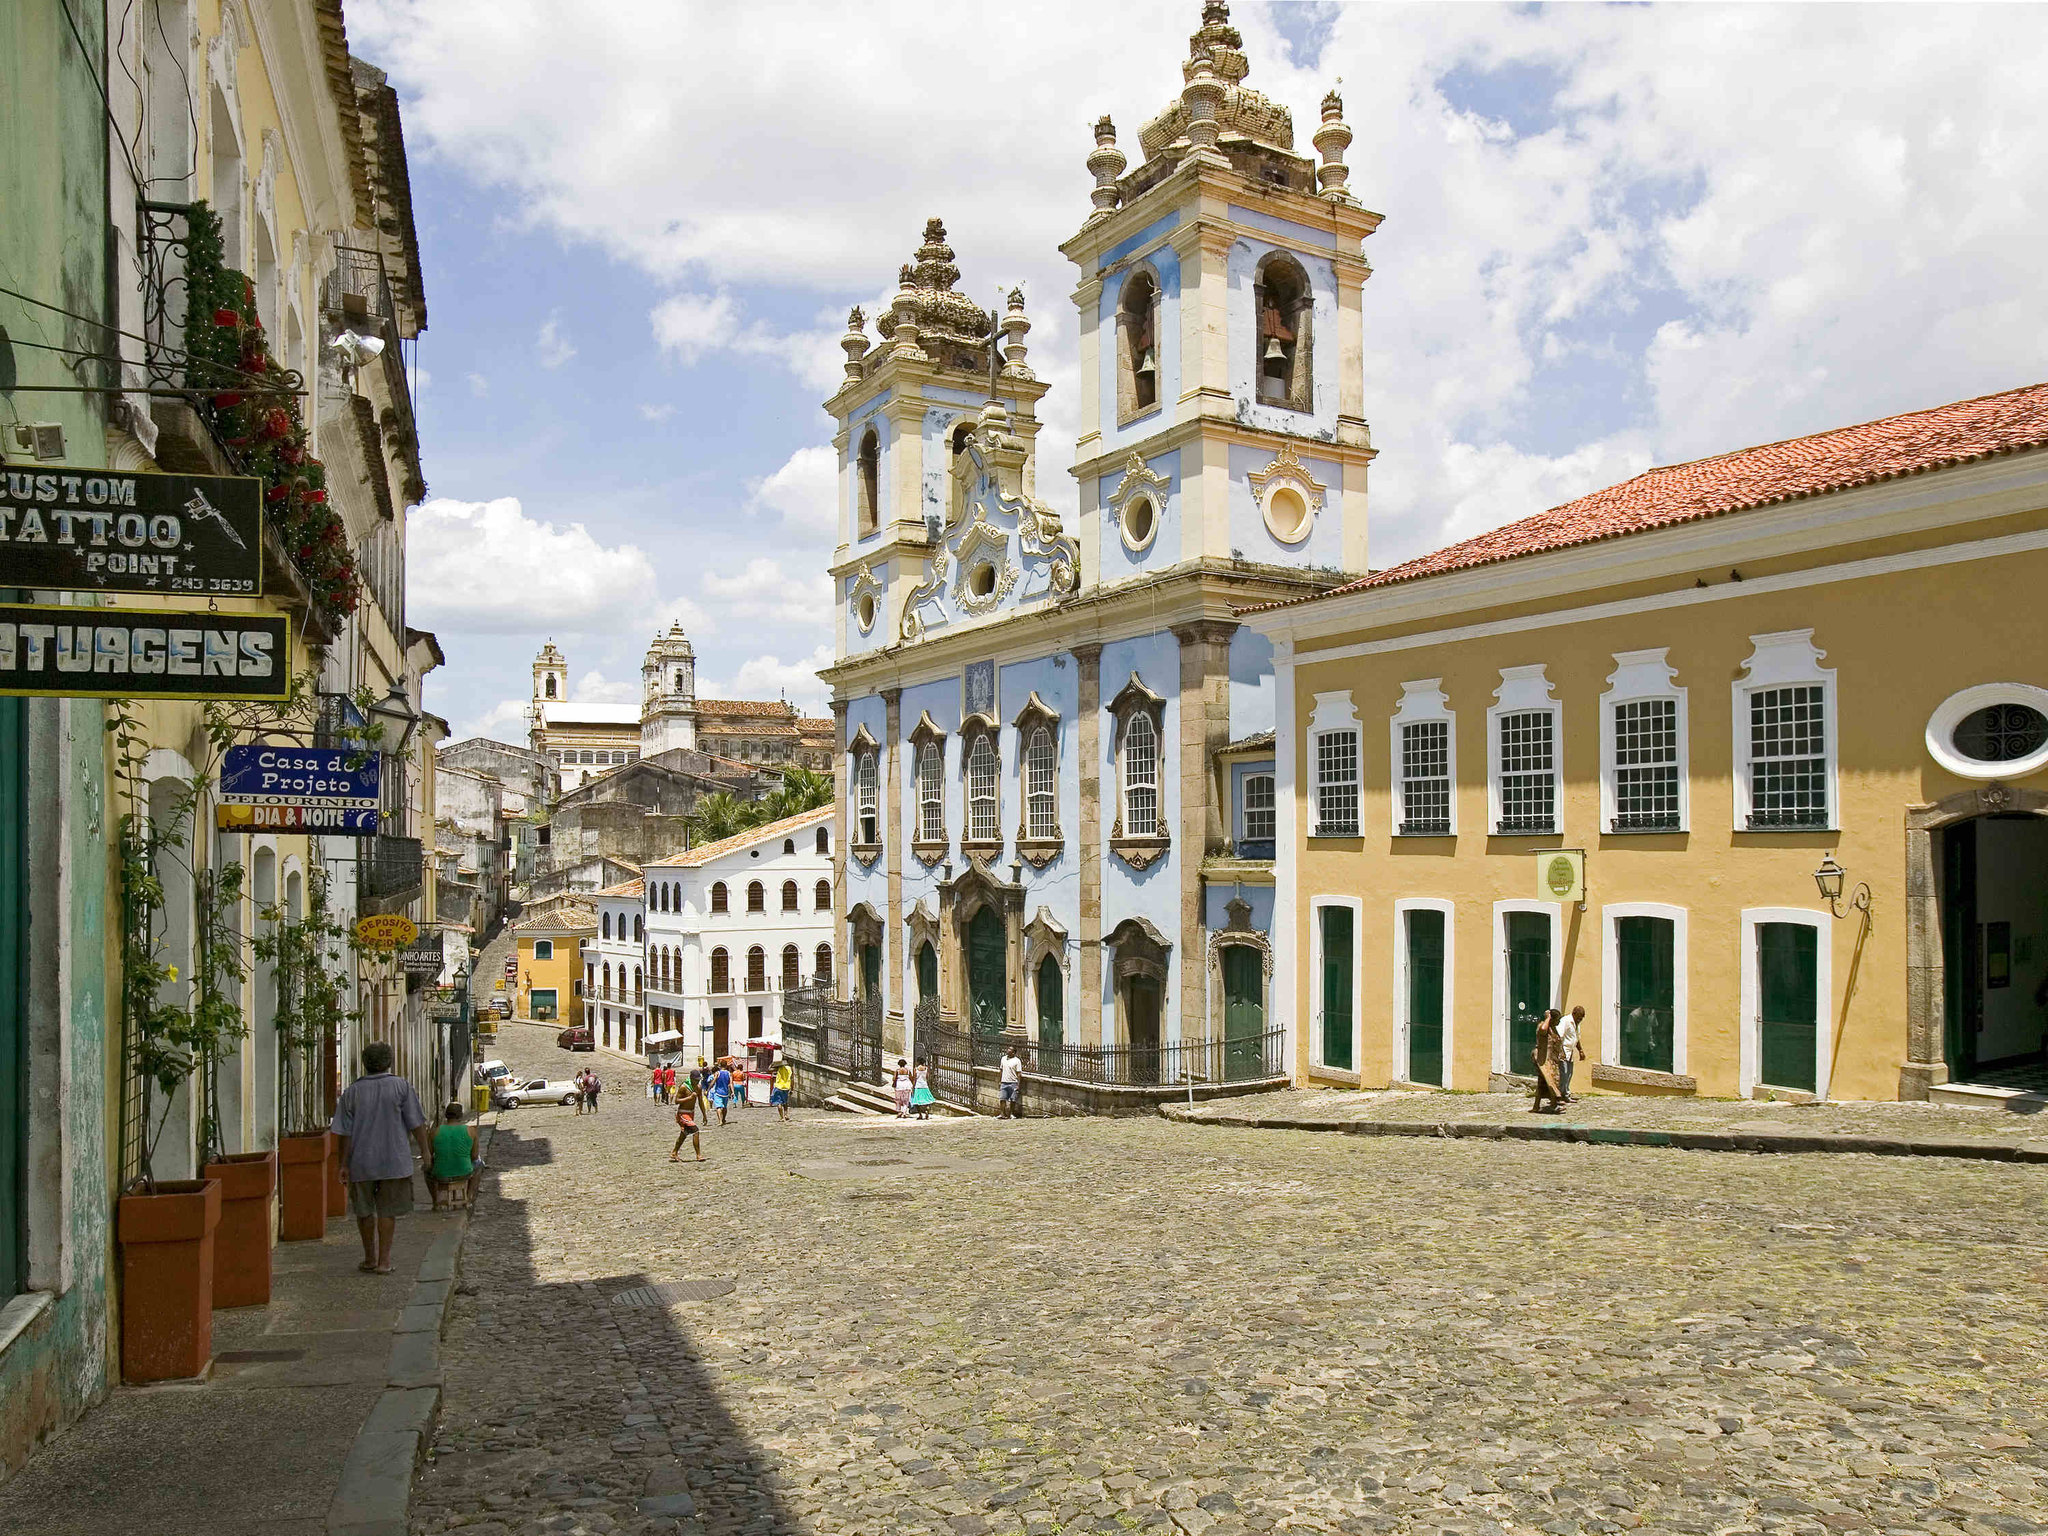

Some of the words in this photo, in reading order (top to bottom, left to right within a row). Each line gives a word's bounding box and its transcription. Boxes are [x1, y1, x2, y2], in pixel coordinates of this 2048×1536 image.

[86, 552, 179, 575] POINT
[171, 577, 204, 590] 243
[209, 578, 254, 592] 3639
[258, 752, 320, 771] Casa
[261, 772, 351, 795] Projeto
[224, 795, 375, 807] PELOURINHO
[254, 807, 281, 825] DIA
[284, 808, 297, 825] &
[301, 807, 345, 827] NOITE
[378, 928, 392, 937] DE
[419, 951, 441, 962] ARTES
